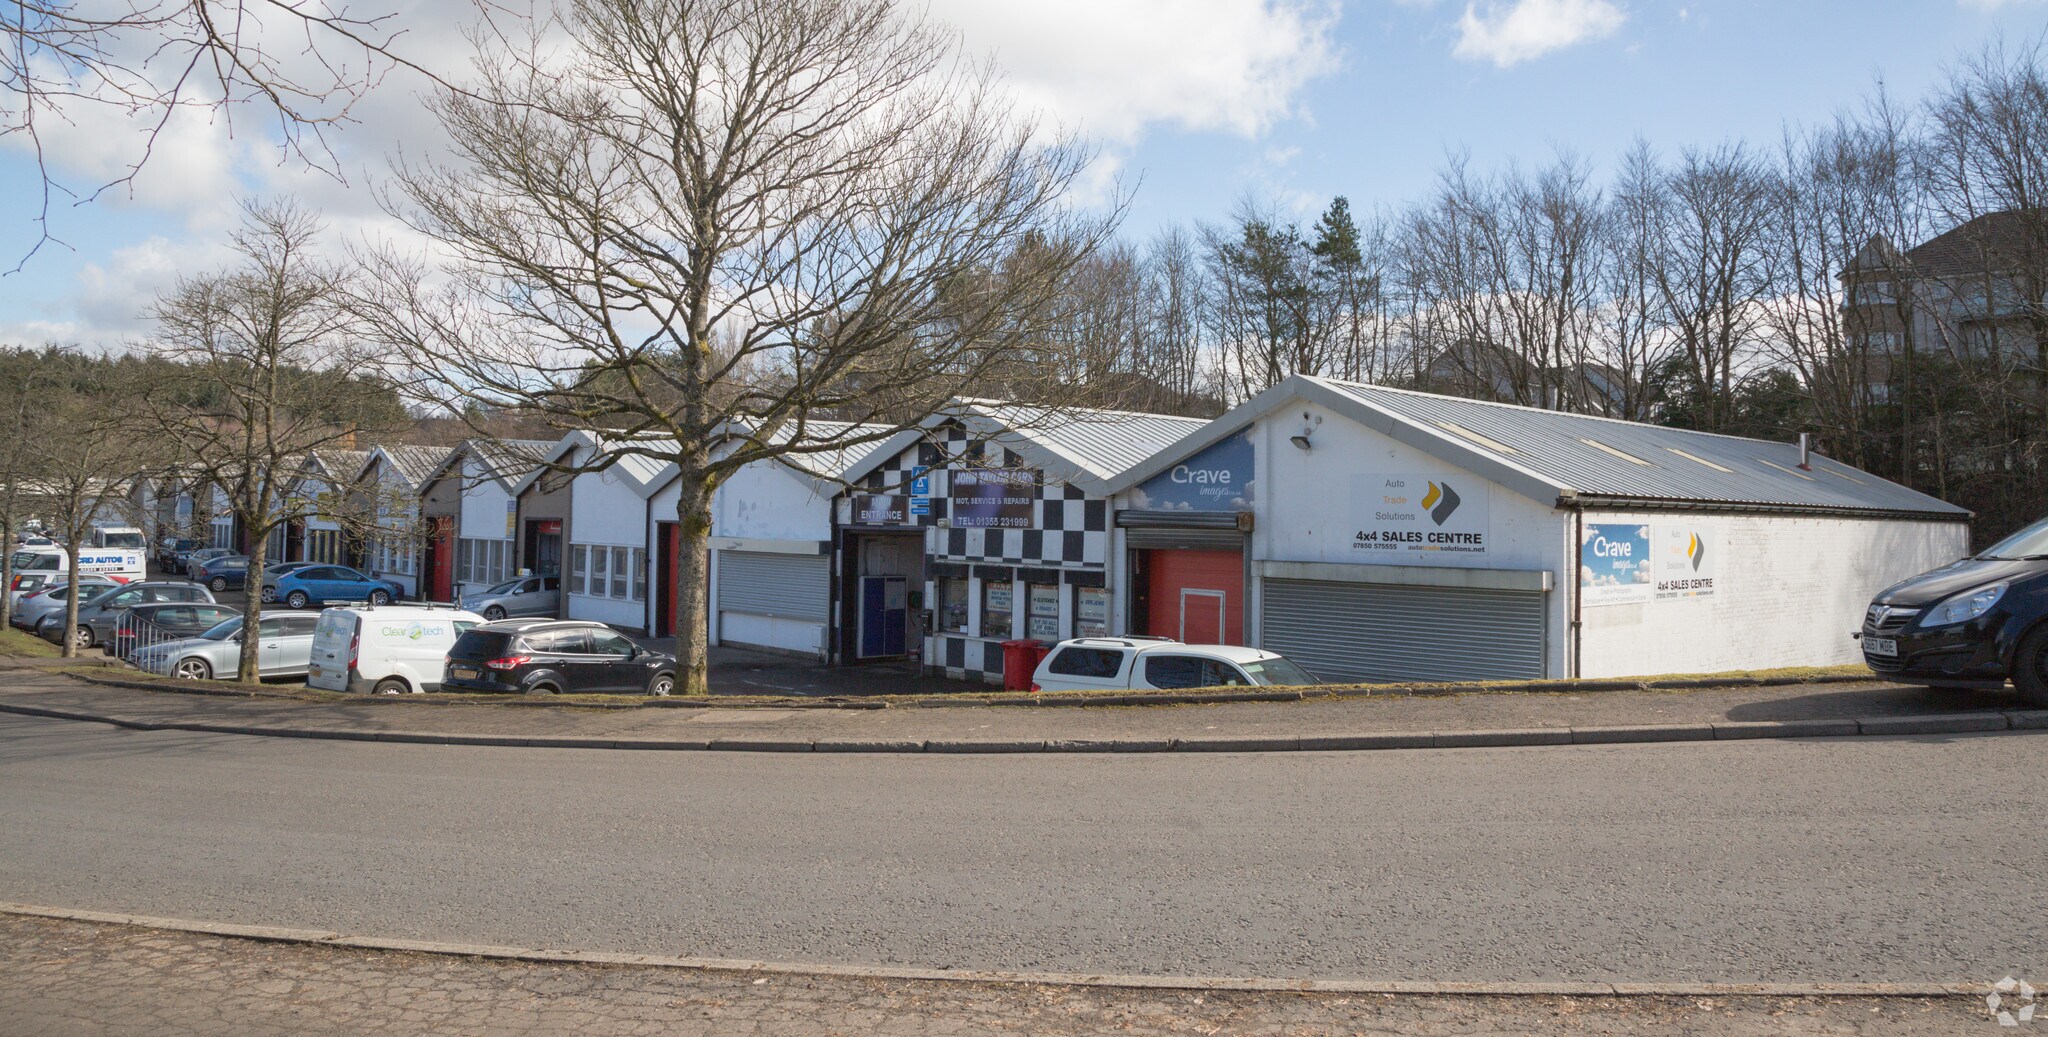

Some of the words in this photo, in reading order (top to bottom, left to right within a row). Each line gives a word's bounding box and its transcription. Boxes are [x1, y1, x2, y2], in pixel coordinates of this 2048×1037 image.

[955, 472, 977, 485] JOHN
[1170, 464, 1231, 483] Crave
[861, 510, 902, 520] ENTRANCE
[1375, 512, 1415, 520] Solutions
[958, 517, 974, 525] TEL:
[976, 517, 998, 526] 01355
[1000, 518, 1028, 526] 231999
[1356, 531, 1377, 541] 4x4
[1382, 531, 1423, 542] SALES
[1428, 533, 1482, 544] CENTRE
[1594, 537, 1631, 557] Crave
[1658, 580, 1669, 590] 4x4
[1670, 580, 1688, 590] SALES
[1691, 578, 1713, 589] CENTRE
[382, 627, 406, 636] Clear
[424, 626, 443, 635] tech
